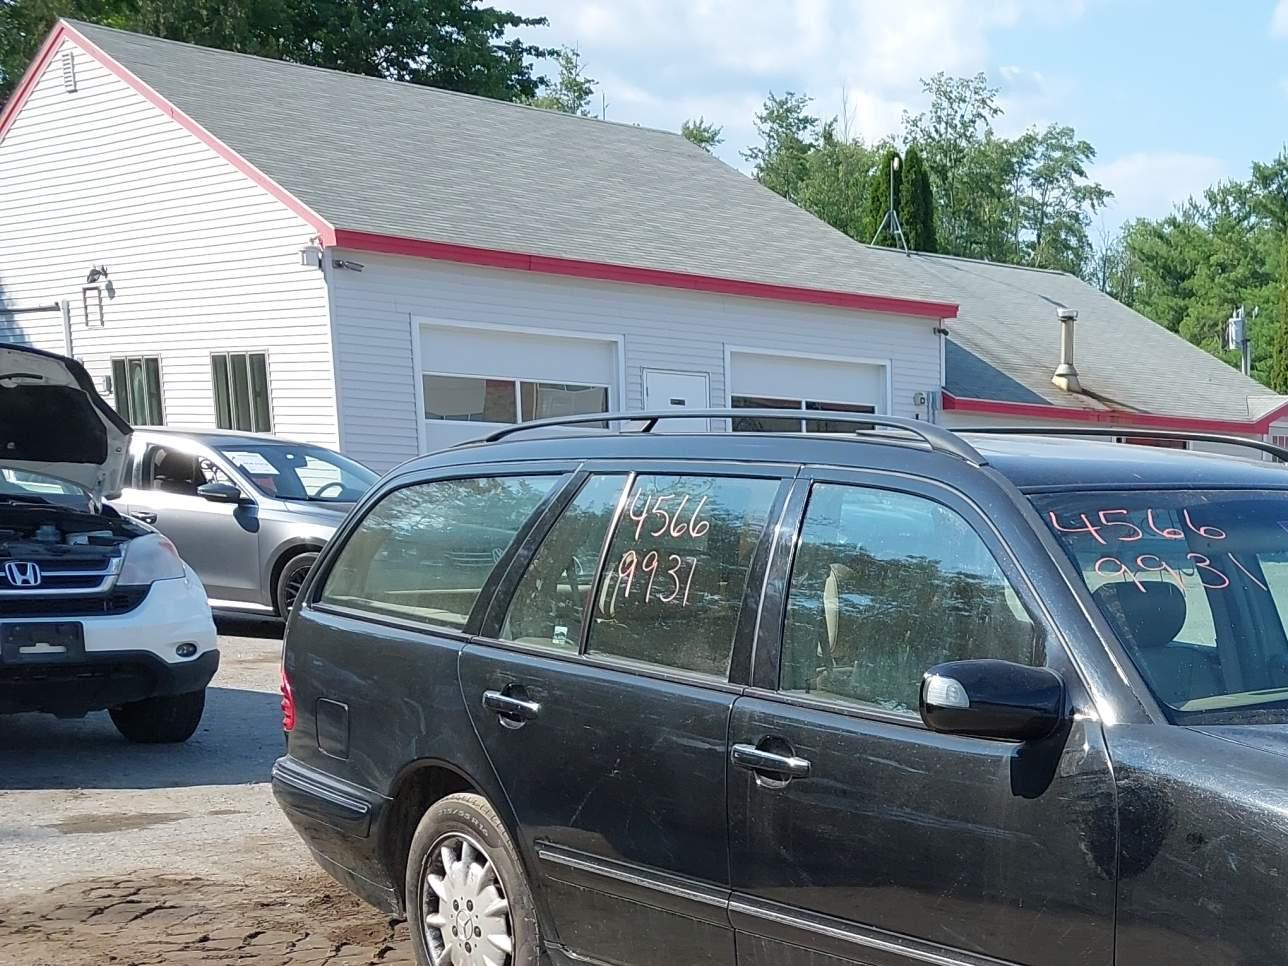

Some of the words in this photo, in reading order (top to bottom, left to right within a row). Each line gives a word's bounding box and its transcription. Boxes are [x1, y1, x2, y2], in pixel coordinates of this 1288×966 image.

[629, 487, 710, 541] 4566
[1049, 508, 1227, 545] 4566
[1094, 552, 1268, 593] 9931
